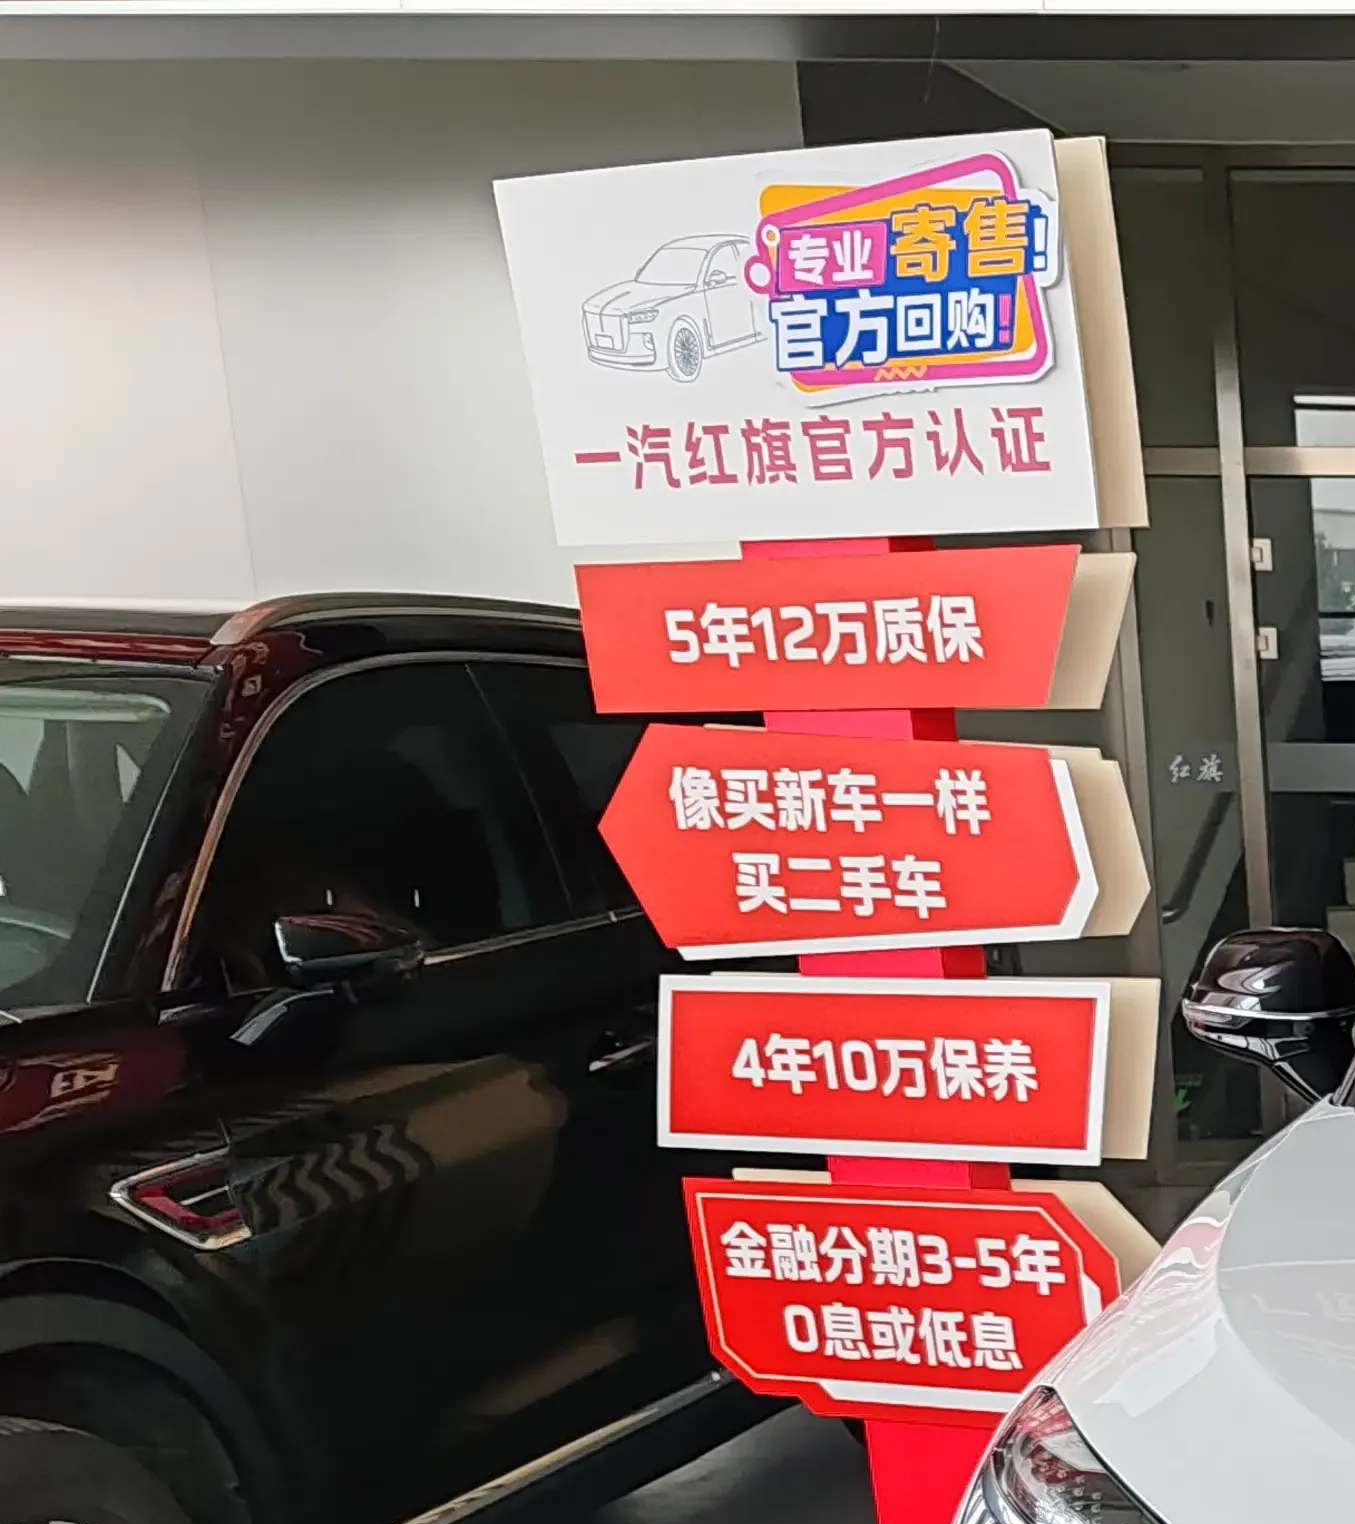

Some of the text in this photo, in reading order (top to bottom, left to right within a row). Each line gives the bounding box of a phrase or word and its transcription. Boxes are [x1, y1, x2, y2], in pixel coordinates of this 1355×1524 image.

[770, 288, 1012, 369] 官方回购!
[574, 406, 1052, 490] 一汽红旗官方认证
[665, 595, 984, 668] 5年12万质保
[669, 766, 991, 836] 像买新车一样
[1168, 753, 1224, 784] 红旗
[732, 852, 947, 919] 买二手车
[732, 1033, 1038, 1102] 4年10万保养
[720, 1221, 1066, 1296] 金融分期3-5年
[783, 1303, 1023, 1371] 0息或低息
